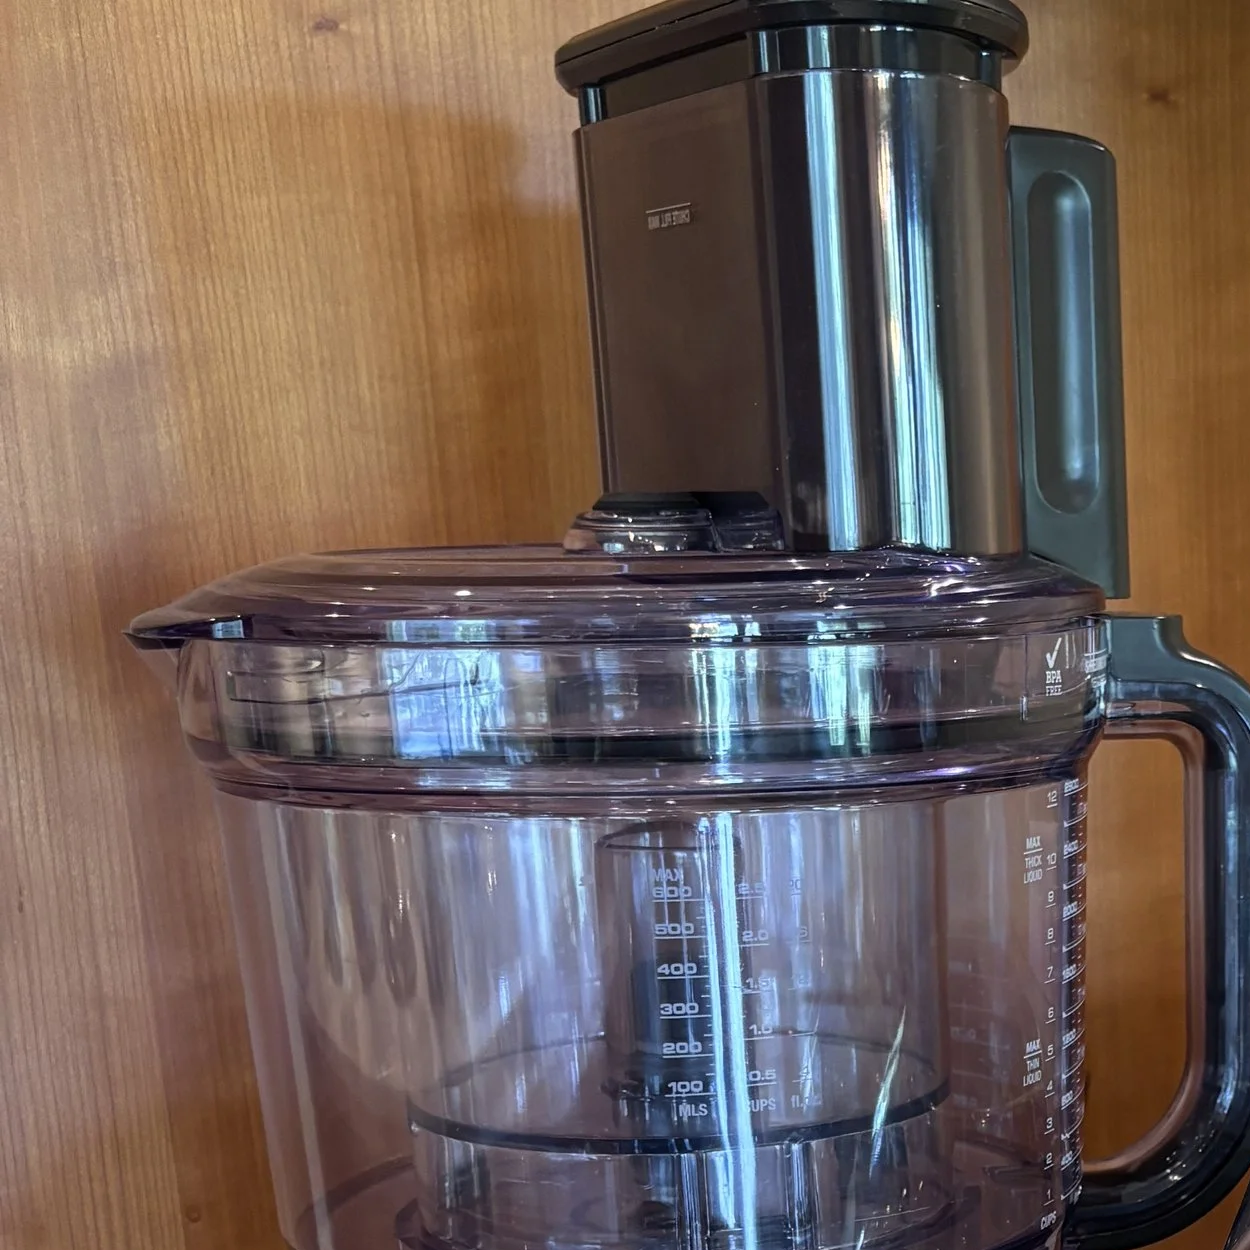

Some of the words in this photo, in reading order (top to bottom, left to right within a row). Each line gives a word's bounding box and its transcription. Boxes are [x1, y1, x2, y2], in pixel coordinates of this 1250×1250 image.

[1045, 670, 1062, 684] BPA
[1047, 790, 1057, 803] 12
[1026, 836, 1041, 849] MAX
[1024, 854, 1042, 869] THICK
[1047, 853, 1056, 865] 10
[651, 868, 682, 882] MAX
[1024, 868, 1043, 884] LIQUID
[652, 886, 692, 898] 600
[654, 922, 695, 935] 500
[742, 929, 769, 941] 2.0
[1047, 928, 1054, 940] 8
[657, 963, 697, 976] 400
[1047, 966, 1054, 978] 7
[660, 1002, 699, 1015] 300
[1047, 1007, 1054, 1018] 6
[662, 1042, 702, 1054] 200
[1025, 1038, 1041, 1054] MAX
[1047, 1045, 1054, 1056] 5
[1026, 1057, 1040, 1072] THIN
[748, 1069, 777, 1081] 0.5
[1023, 1070, 1042, 1087] LIQUID
[668, 1080, 704, 1093] 100
[1046, 1080, 1053, 1092] 4
[679, 1102, 708, 1117] MLS
[1046, 1117, 1053, 1129] 3
[1046, 1152, 1053, 1165] 2
